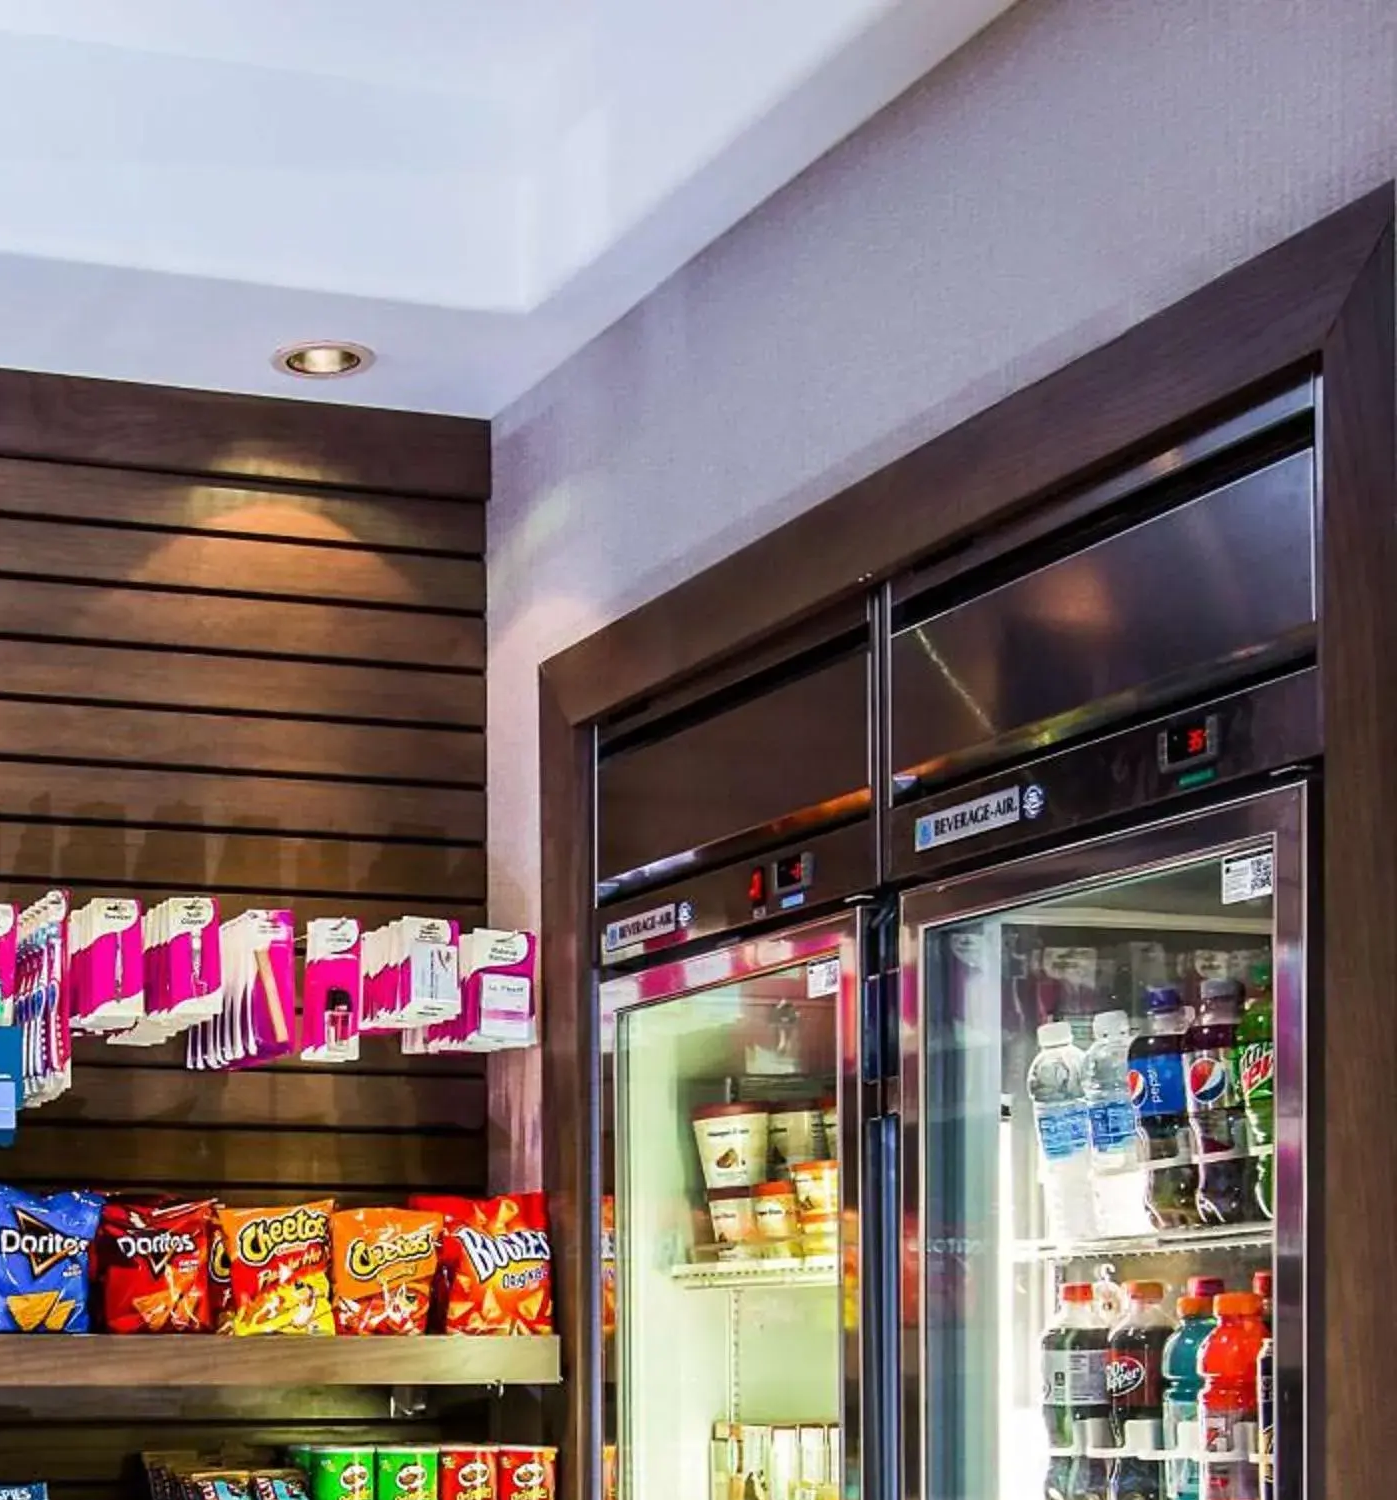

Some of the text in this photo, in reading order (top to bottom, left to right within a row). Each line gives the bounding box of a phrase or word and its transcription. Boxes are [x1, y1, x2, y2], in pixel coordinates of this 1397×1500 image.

[1, 1228, 90, 1256] Doritos
[117, 1231, 196, 1258] Doritos
[240, 1209, 328, 1266] Cheetos
[457, 1227, 551, 1283] BUGLES
